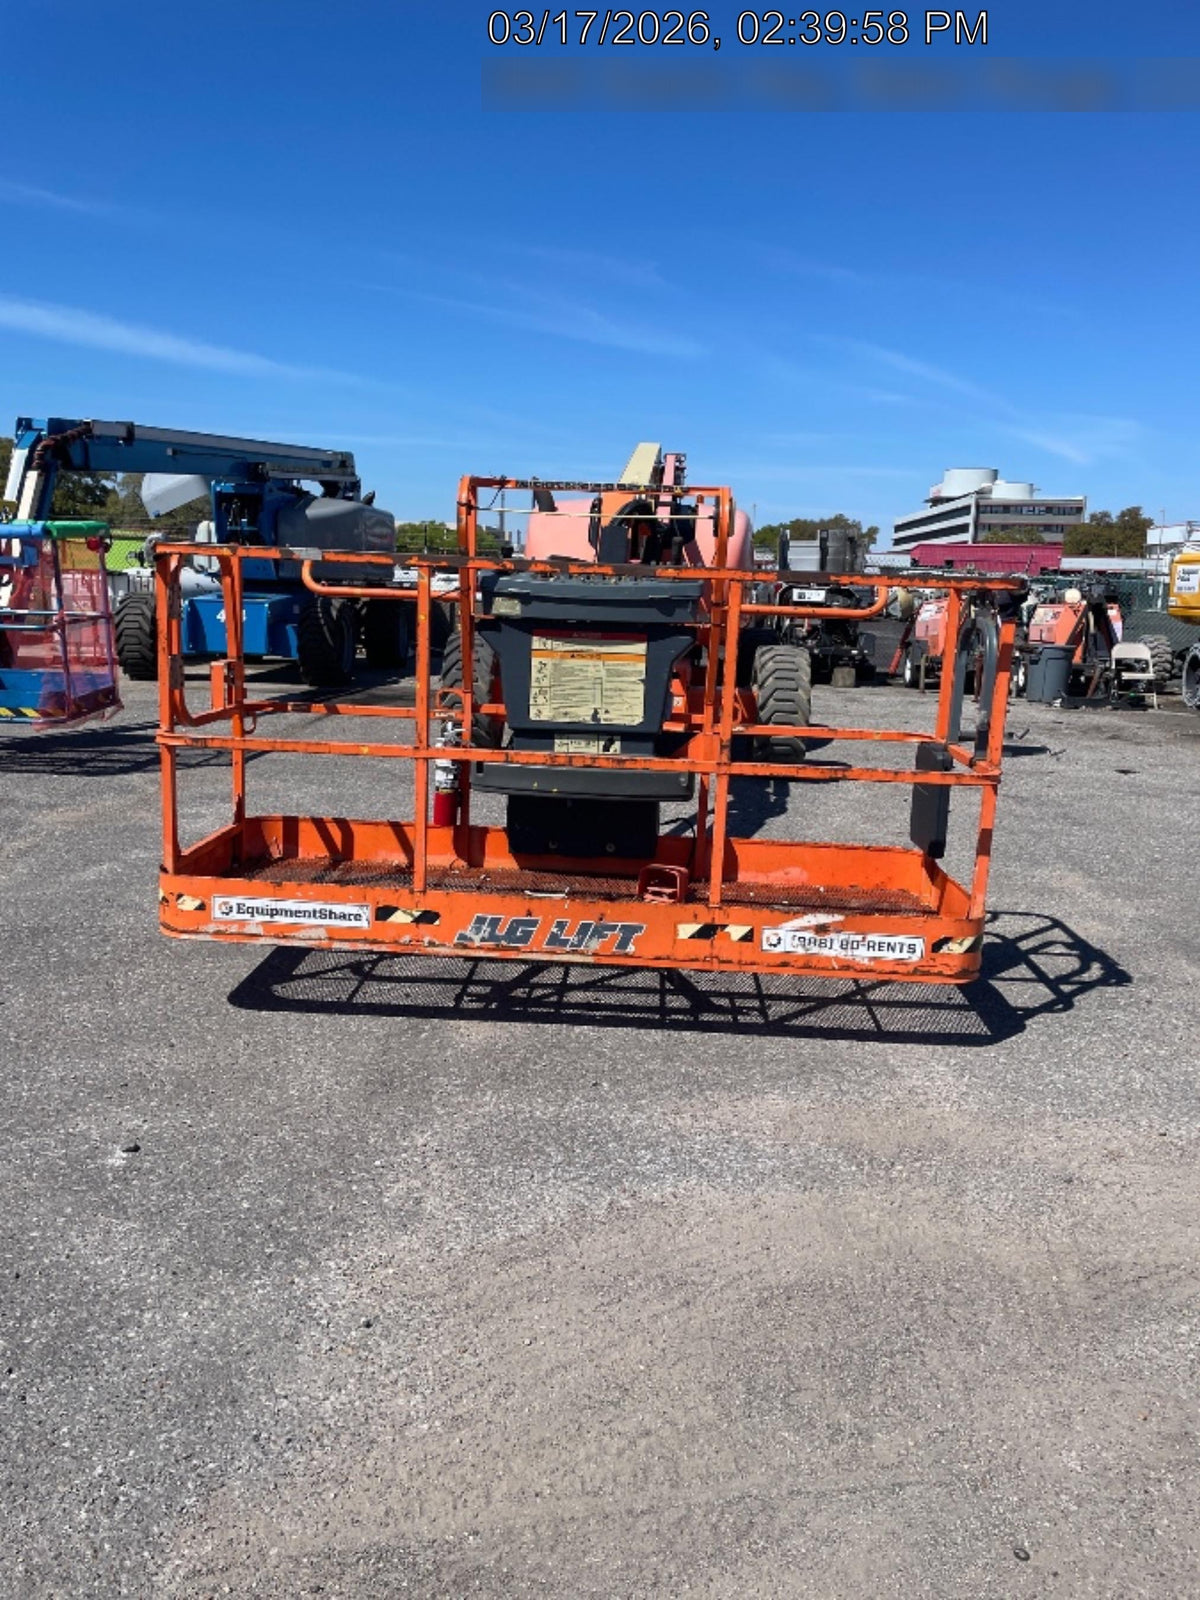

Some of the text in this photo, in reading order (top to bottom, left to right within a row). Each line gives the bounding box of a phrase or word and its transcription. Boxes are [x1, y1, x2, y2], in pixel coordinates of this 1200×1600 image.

[235, 902, 363, 922] EquipmentShare
[454, 913, 648, 953] JLG LIFT
